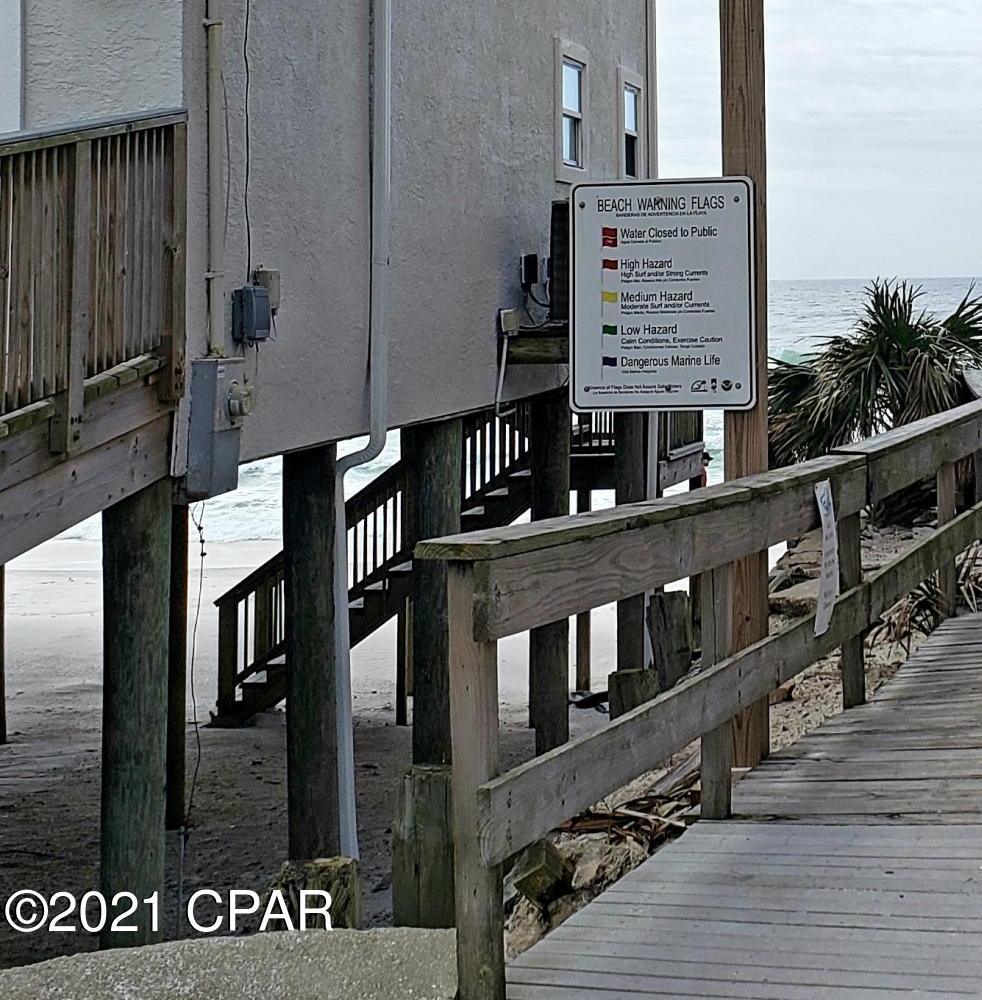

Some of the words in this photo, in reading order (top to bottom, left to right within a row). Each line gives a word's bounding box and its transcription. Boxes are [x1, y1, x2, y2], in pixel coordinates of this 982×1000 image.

[597, 198, 632, 212] BEACH
[637, 197, 686, 211] WARNING
[691, 196, 725, 210] FLAGS
[621, 228, 646, 239] Water
[648, 227, 678, 238] Closed
[680, 227, 689, 238] to
[691, 226, 718, 237] Public
[621, 258, 640, 271] High
[642, 257, 673, 269] Hazard
[621, 290, 657, 303] Medium
[660, 290, 693, 301] Hazard
[621, 324, 640, 336] Low
[643, 323, 678, 335] Hazard
[621, 356, 669, 369] Dangerous
[671, 354, 702, 366] Marine
[704, 354, 721, 366] Life
